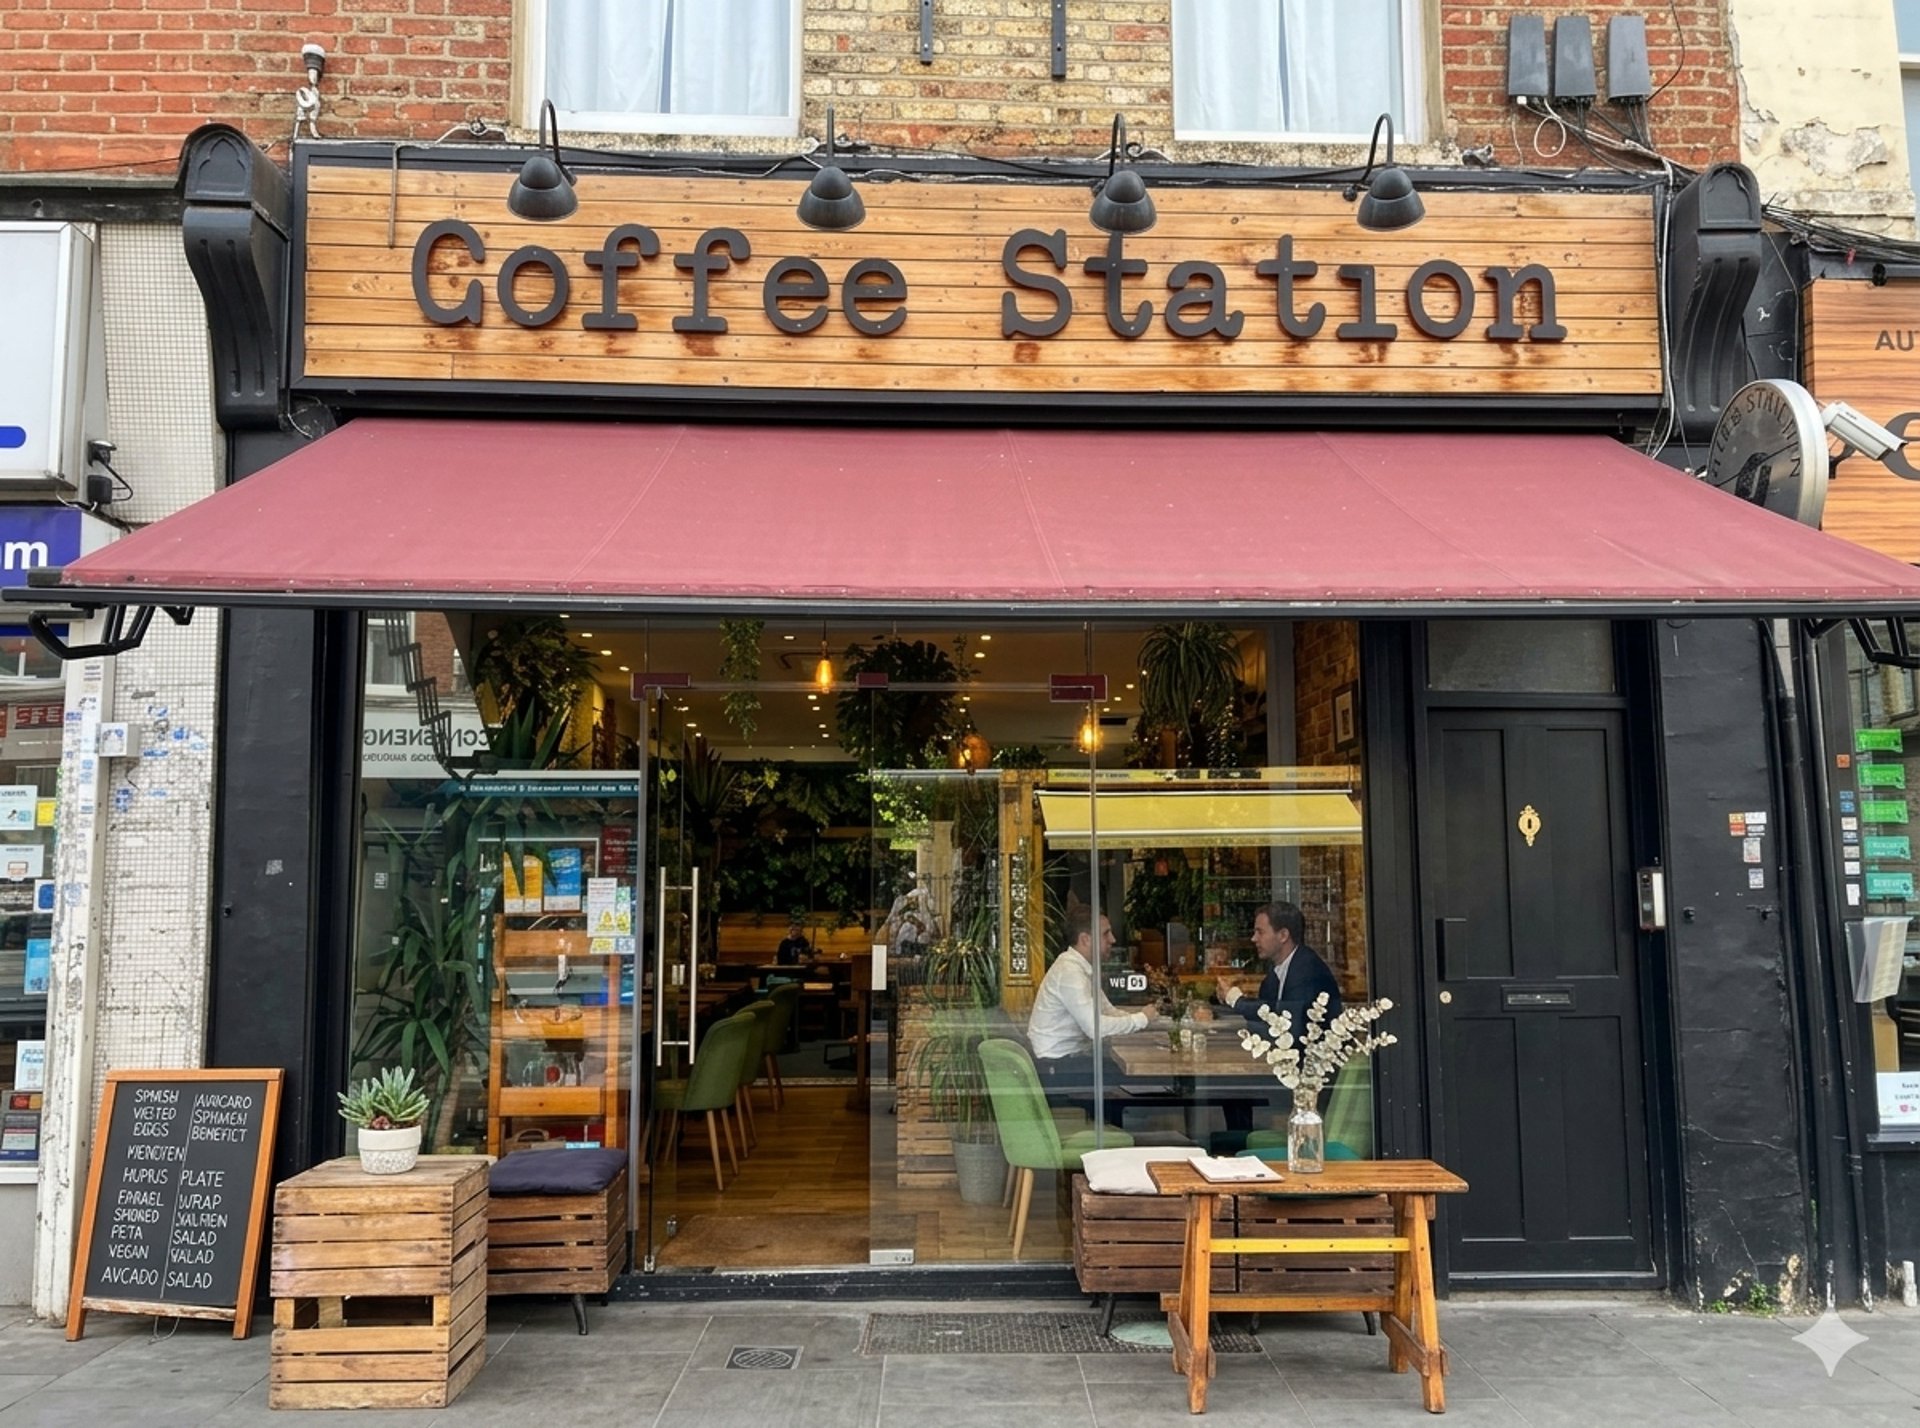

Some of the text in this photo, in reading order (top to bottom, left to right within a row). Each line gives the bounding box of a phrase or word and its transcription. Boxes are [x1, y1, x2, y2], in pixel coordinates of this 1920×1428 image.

[412, 219, 1567, 341] Coffee Station
[1875, 330, 1920, 351] AU
[0, 541, 48, 570] m
[180, 1170, 225, 1187] PLATE
[172, 1229, 217, 1246] SALAD
[108, 1244, 150, 1259] VEGAN
[100, 1266, 213, 1289] AVCADO SALAD
